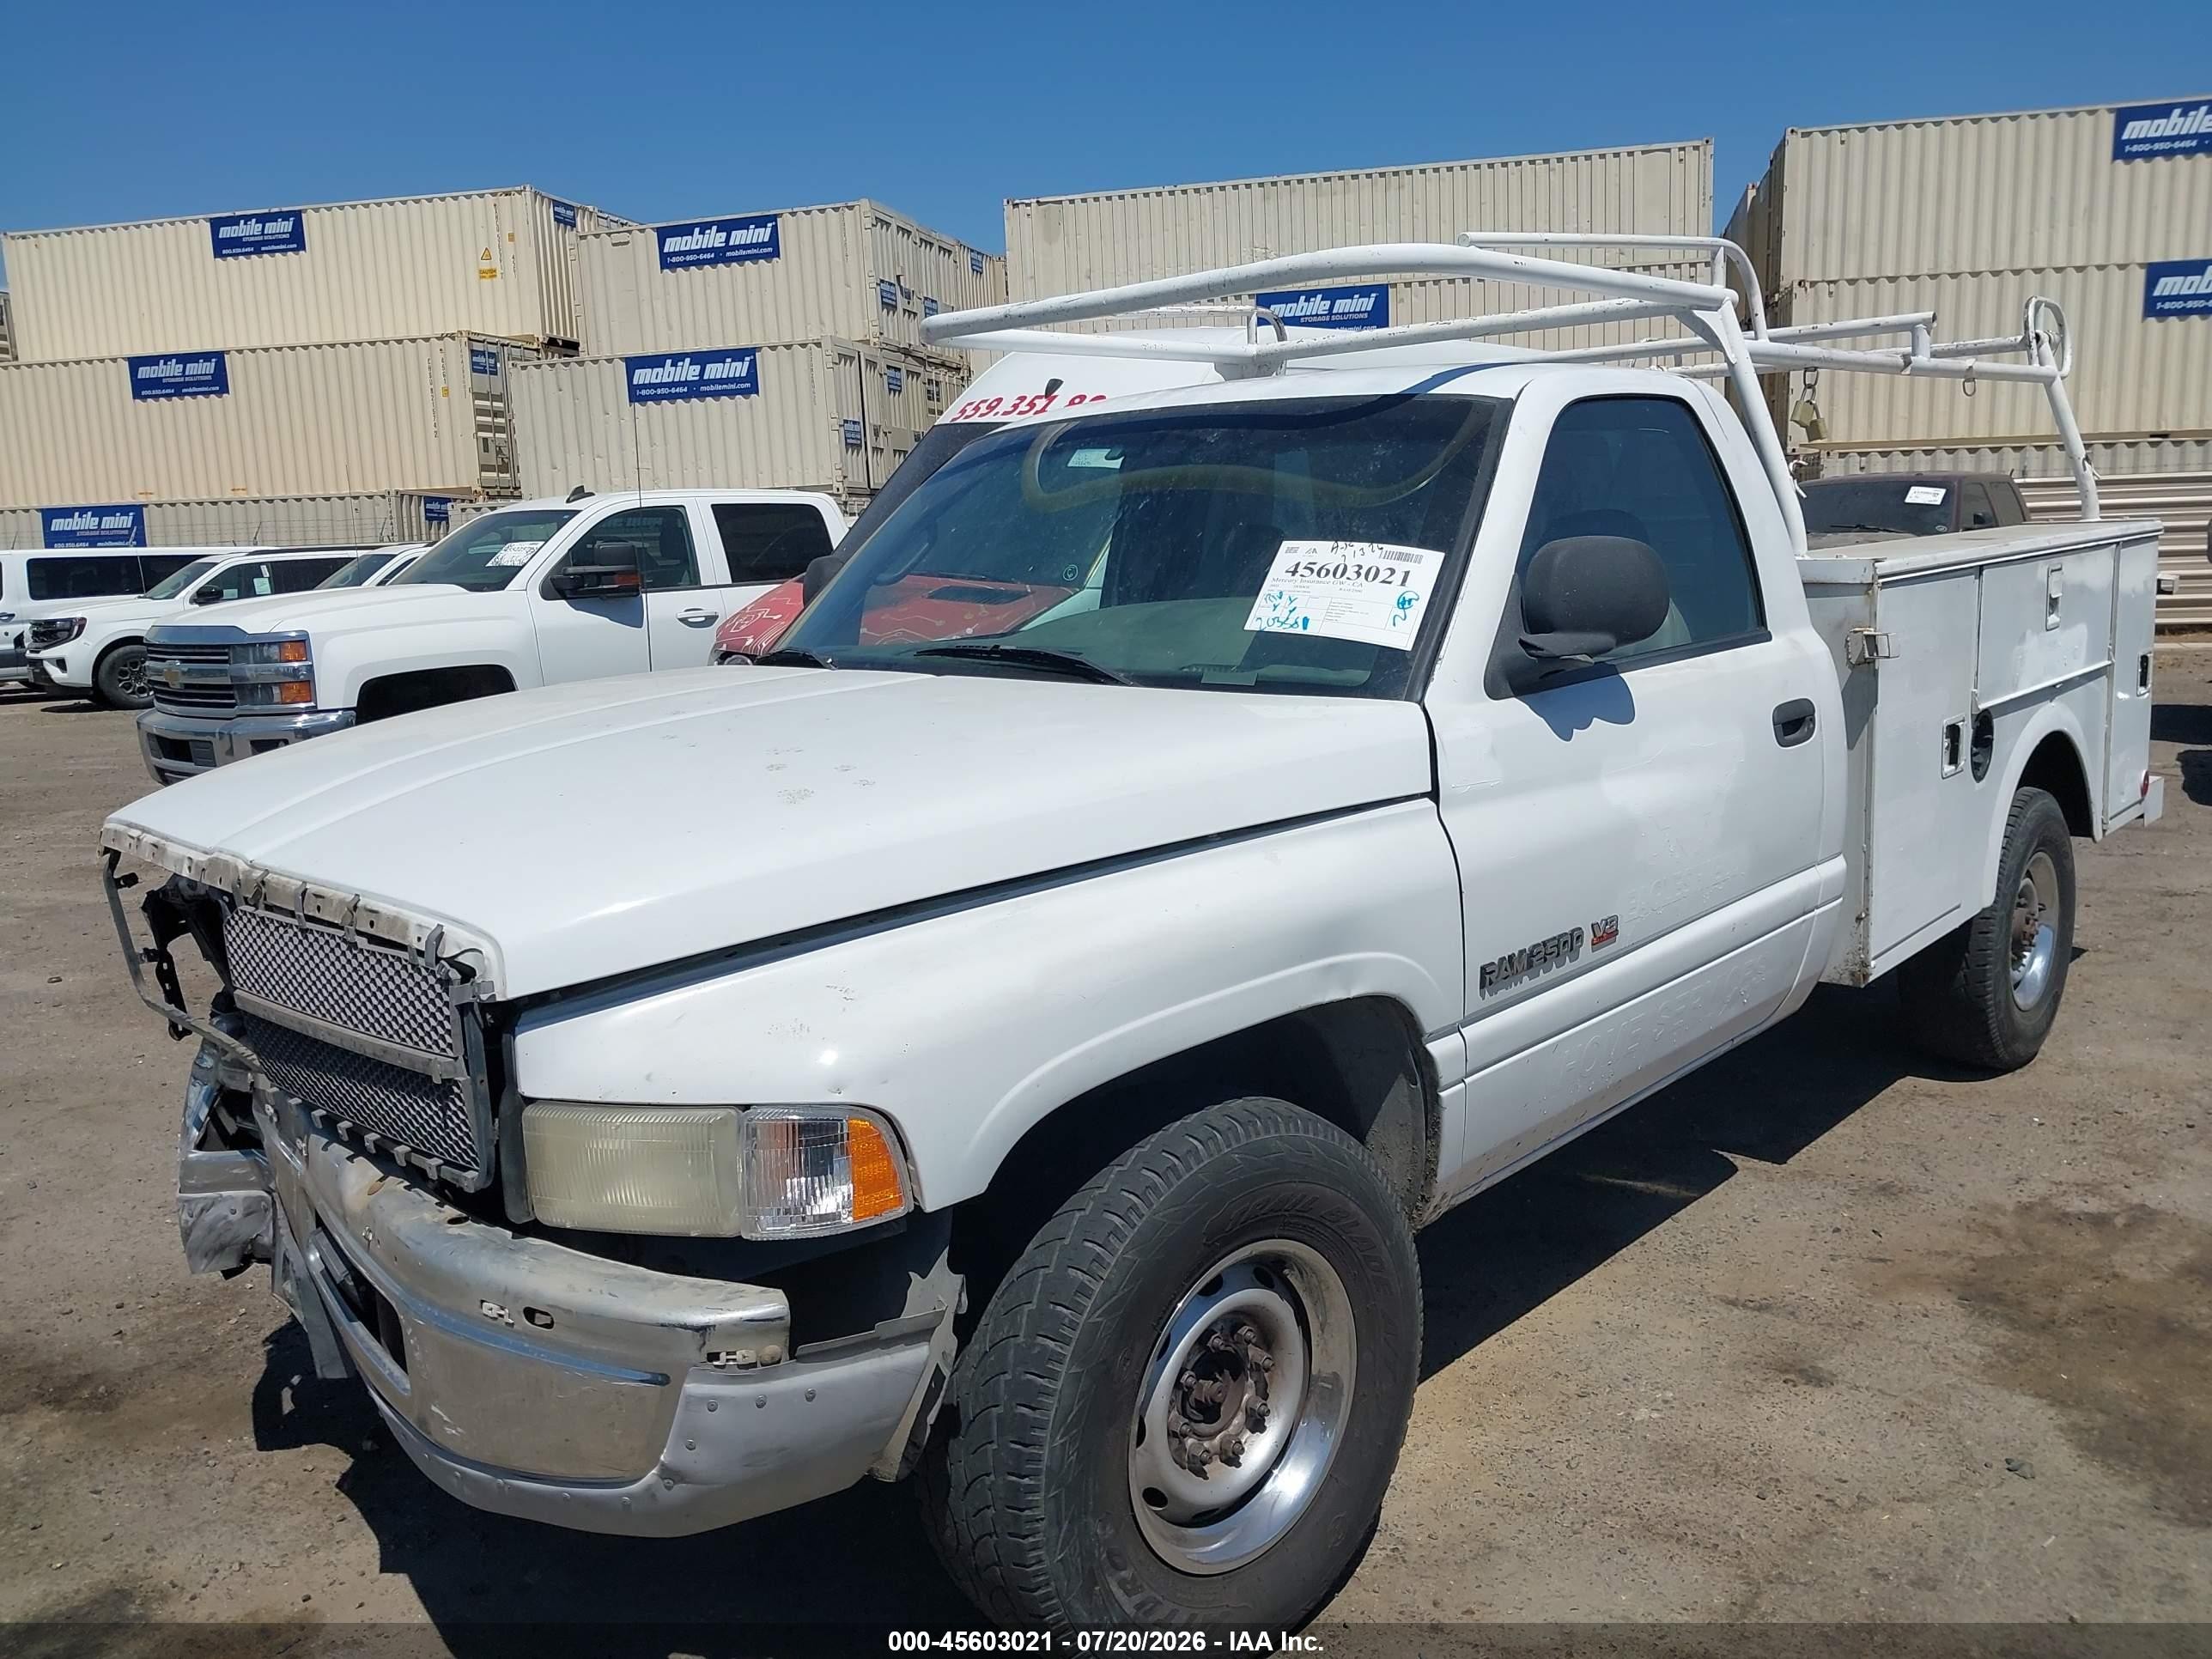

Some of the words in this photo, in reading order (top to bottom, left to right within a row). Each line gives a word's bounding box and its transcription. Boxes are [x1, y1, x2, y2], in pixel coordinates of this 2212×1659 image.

[2121, 106, 2212, 140] mobile
[218, 218, 263, 239] mobile
[264, 217, 295, 234] mini
[663, 225, 727, 252] mobile
[729, 222, 773, 246] mini
[726, 246, 774, 258] mobilemini.com
[1270, 295, 1331, 318] mobile
[1332, 293, 1377, 313] mini
[1331, 313, 1369, 321] SOLUTIONS
[137, 359, 183, 379] mobile
[185, 358, 217, 375] mini
[633, 357, 701, 385] mobile
[702, 356, 751, 380] mini
[700, 382, 751, 392] mobilemini.com
[51, 511, 99, 532] mobile
[100, 512, 135, 529] mini
[1285, 561, 1411, 587] 45603021
